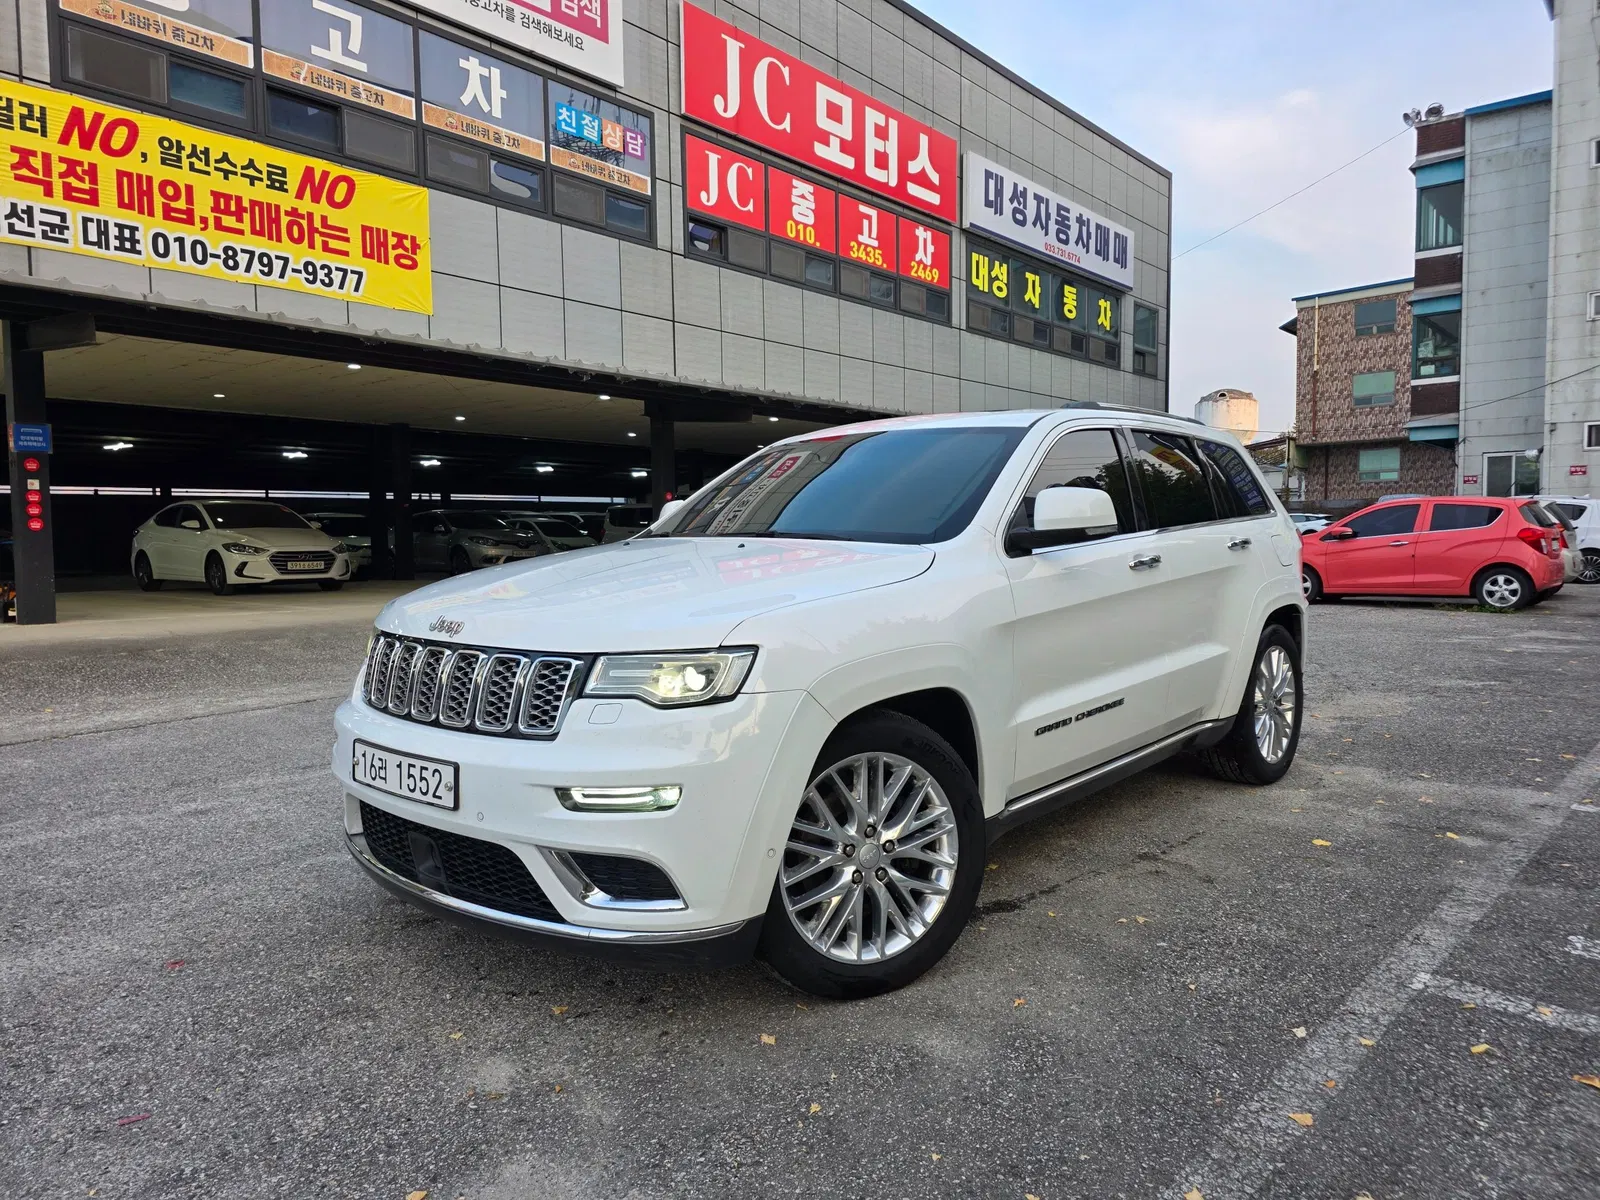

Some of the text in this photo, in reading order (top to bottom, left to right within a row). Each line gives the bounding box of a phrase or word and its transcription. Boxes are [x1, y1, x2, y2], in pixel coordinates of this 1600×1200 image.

[171, 25, 215, 52] 중고차
[310, 0, 508, 120] 고 차
[519, 12, 585, 51] 검색해보세요
[350, 84, 386, 107] 중고차
[714, 34, 941, 206] JC 모터스
[492, 131, 521, 150] 중고차
[556, 106, 644, 158] 친절상담
[157, 136, 289, 195] 알선수수료
[294, 164, 357, 211] NO
[9, 145, 100, 208] 직접
[361, 223, 422, 272] 매장
[700, 150, 935, 266] JC 중 고 차
[984, 168, 1129, 271] 대성자동차매매
[81, 214, 143, 257] 대표
[152, 231, 365, 294] 010-8797-9377
[910, 261, 940, 284] 2469
[971, 251, 1112, 332] 대성 자 동 차
[428, 614, 466, 639] Jeep
[1034, 697, 1126, 737] GRAND CHEROKEE
[361, 749, 443, 806] 16러 1552
